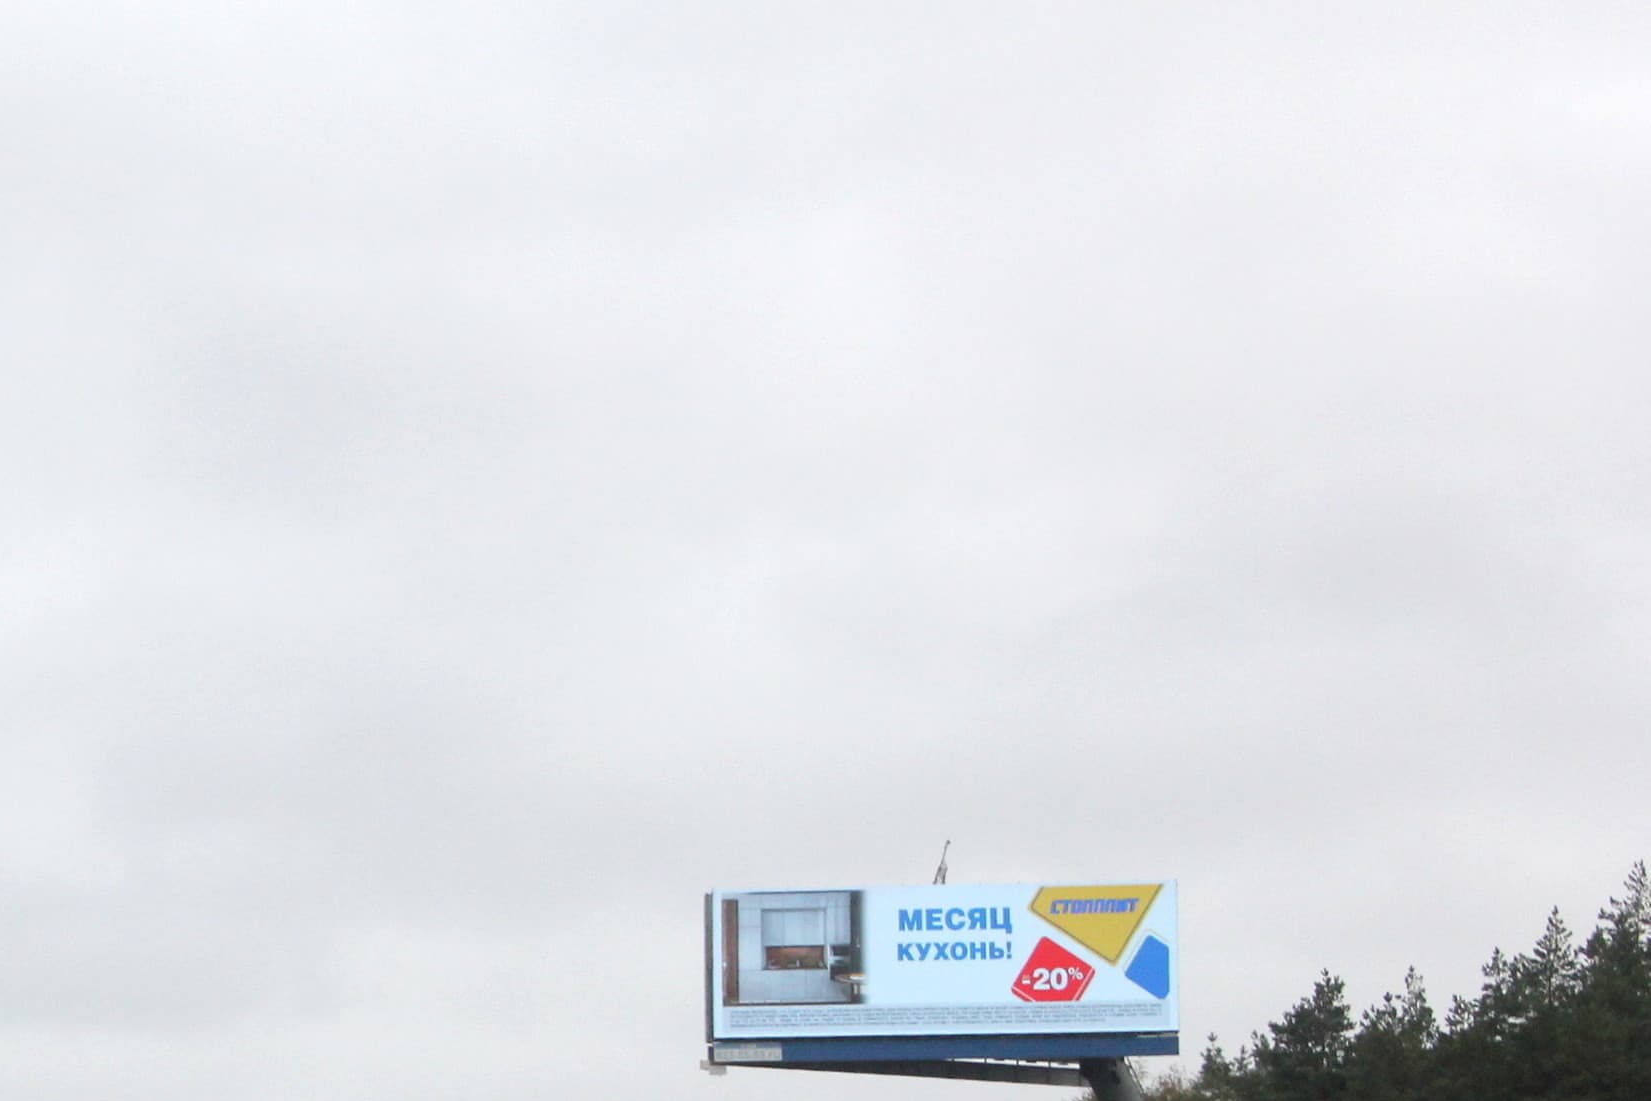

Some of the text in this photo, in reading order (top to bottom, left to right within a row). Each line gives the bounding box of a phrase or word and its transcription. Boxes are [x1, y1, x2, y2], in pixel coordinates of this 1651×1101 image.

[898, 907, 1013, 934] МЕСЯЦ
[897, 942, 1013, 961] КУХОНЬ!
[1021, 967, 1084, 991] -20%
